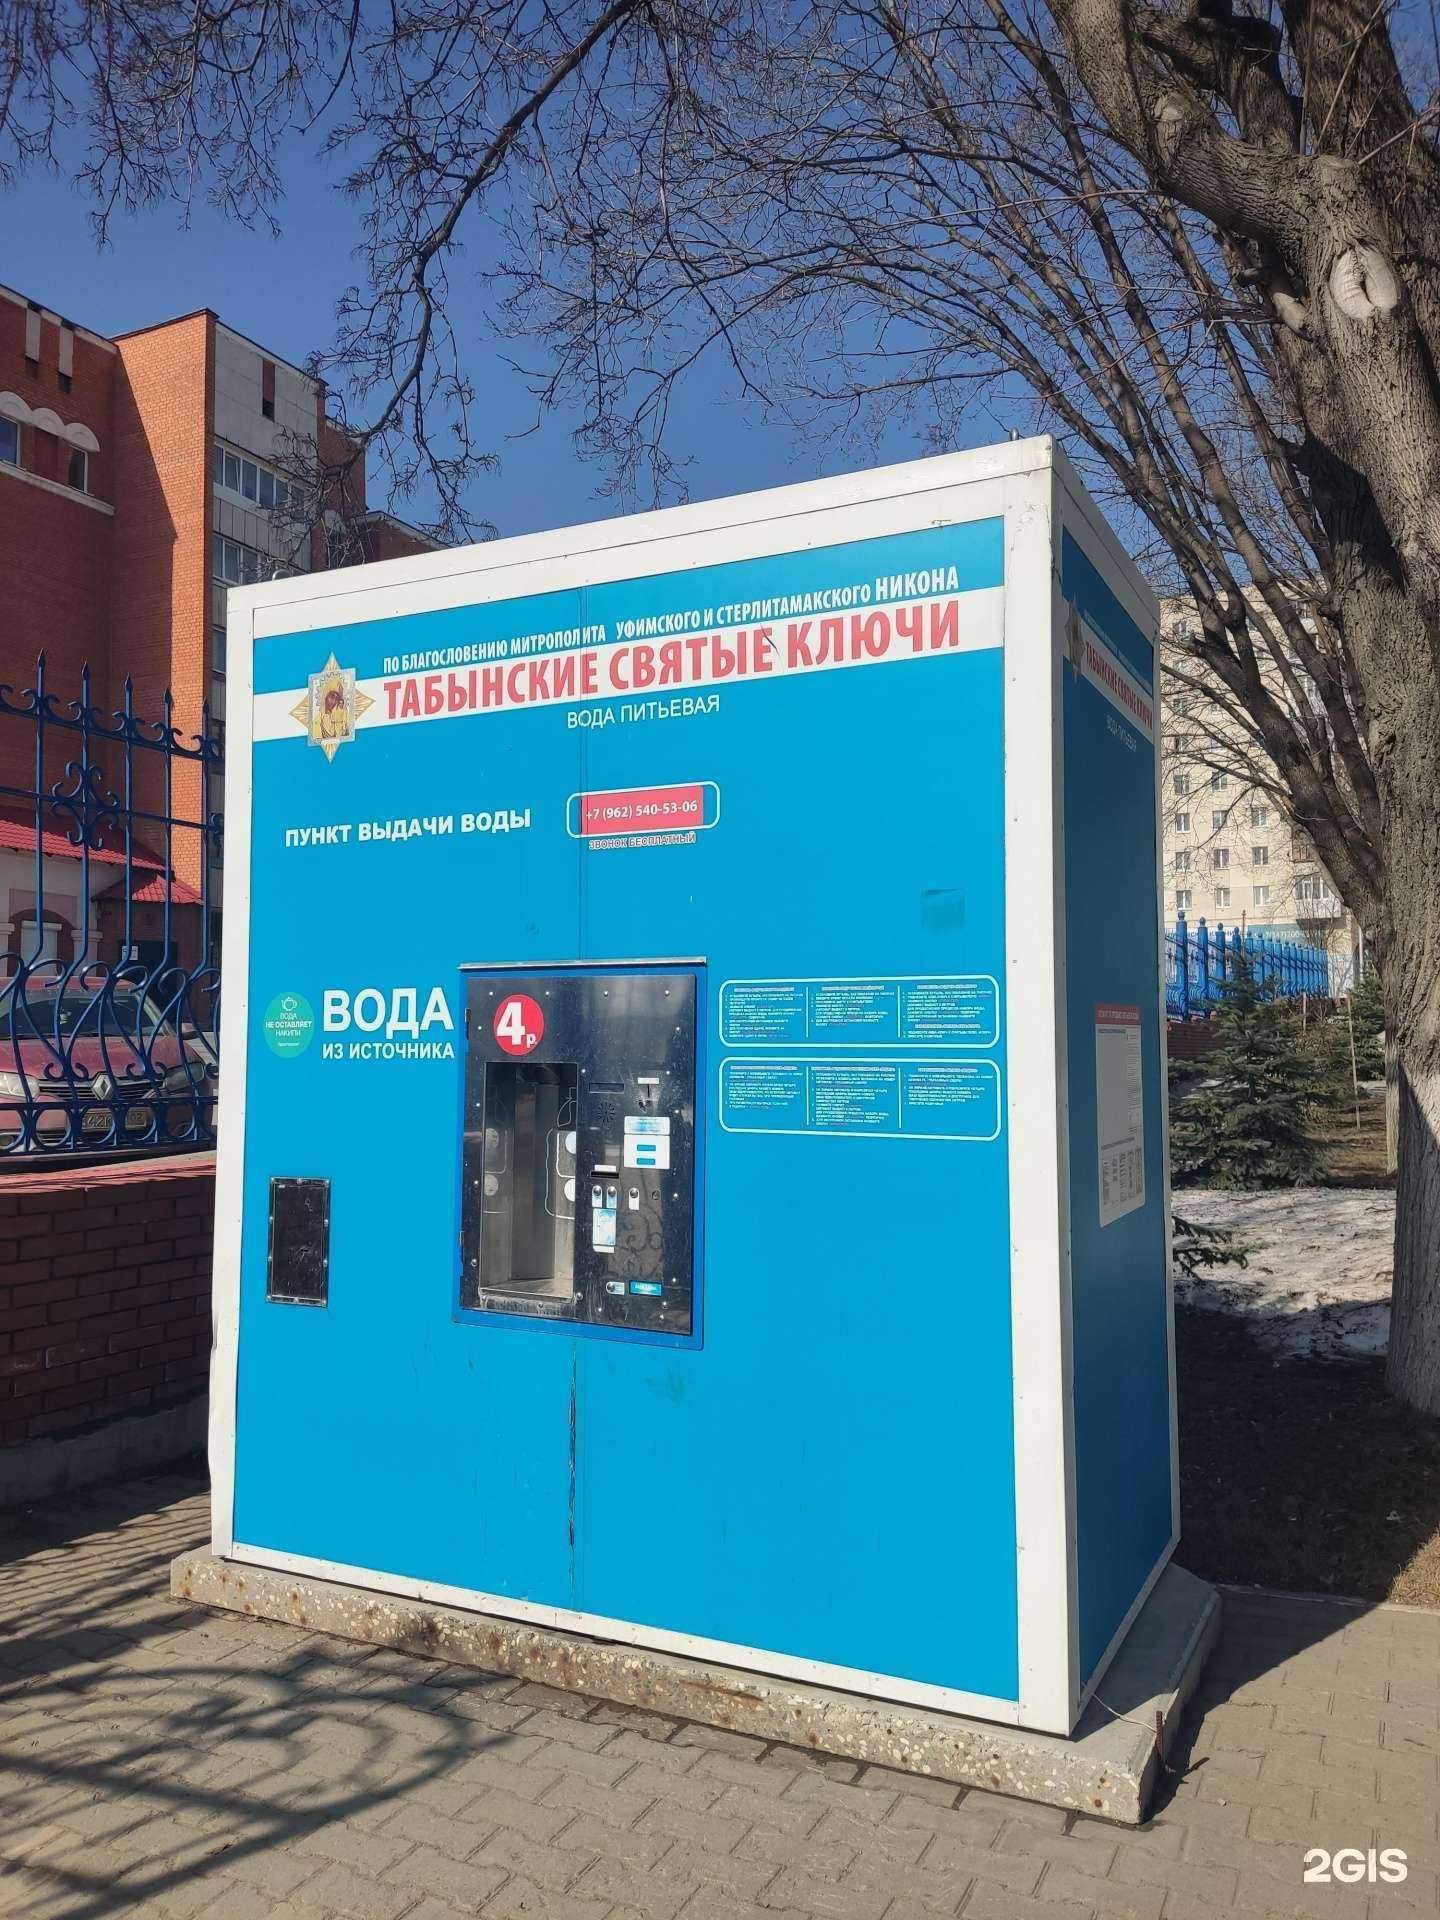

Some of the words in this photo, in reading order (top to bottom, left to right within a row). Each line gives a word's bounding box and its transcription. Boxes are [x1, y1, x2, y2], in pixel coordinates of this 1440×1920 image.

[384, 656, 400, 674] ПО
[401, 640, 508, 670] БЛАГОСЛОВЕНИЮ
[510, 624, 606, 655] МИТРОПОЛИТА
[615, 611, 700, 641] УФИМСКОГО
[703, 609, 714, 627] И
[716, 583, 872, 626] СТЕРЛИТАМАКСКОГО
[875, 566, 959, 602] НИКОНА
[383, 652, 599, 720] ТАБЫНСКИЕ
[609, 626, 773, 691] СВЯТЫЕ
[787, 600, 959, 669] КЛЮЧИ
[567, 707, 616, 730] ВОДА
[620, 694, 720, 723] ПИТЬЕВАЯ
[285, 824, 352, 847] ПУНКТ
[358, 815, 454, 842] ВЫДАЧИ
[460, 808, 531, 834] ВОДЫ
[586, 808, 601, 821] +7
[602, 804, 633, 821] (962)
[635, 800, 698, 817] 540-53-06
[588, 837, 628, 851] ЗВОНОК
[628, 831, 697, 848] БЕСПЛАТНЫЙ
[275, 1020, 312, 1029] ОСТАВЛЯЕТ
[323, 986, 455, 1039] ВОДА
[322, 1042, 344, 1059] ИЗ
[349, 1042, 455, 1060] ИСТОЧНИКА
